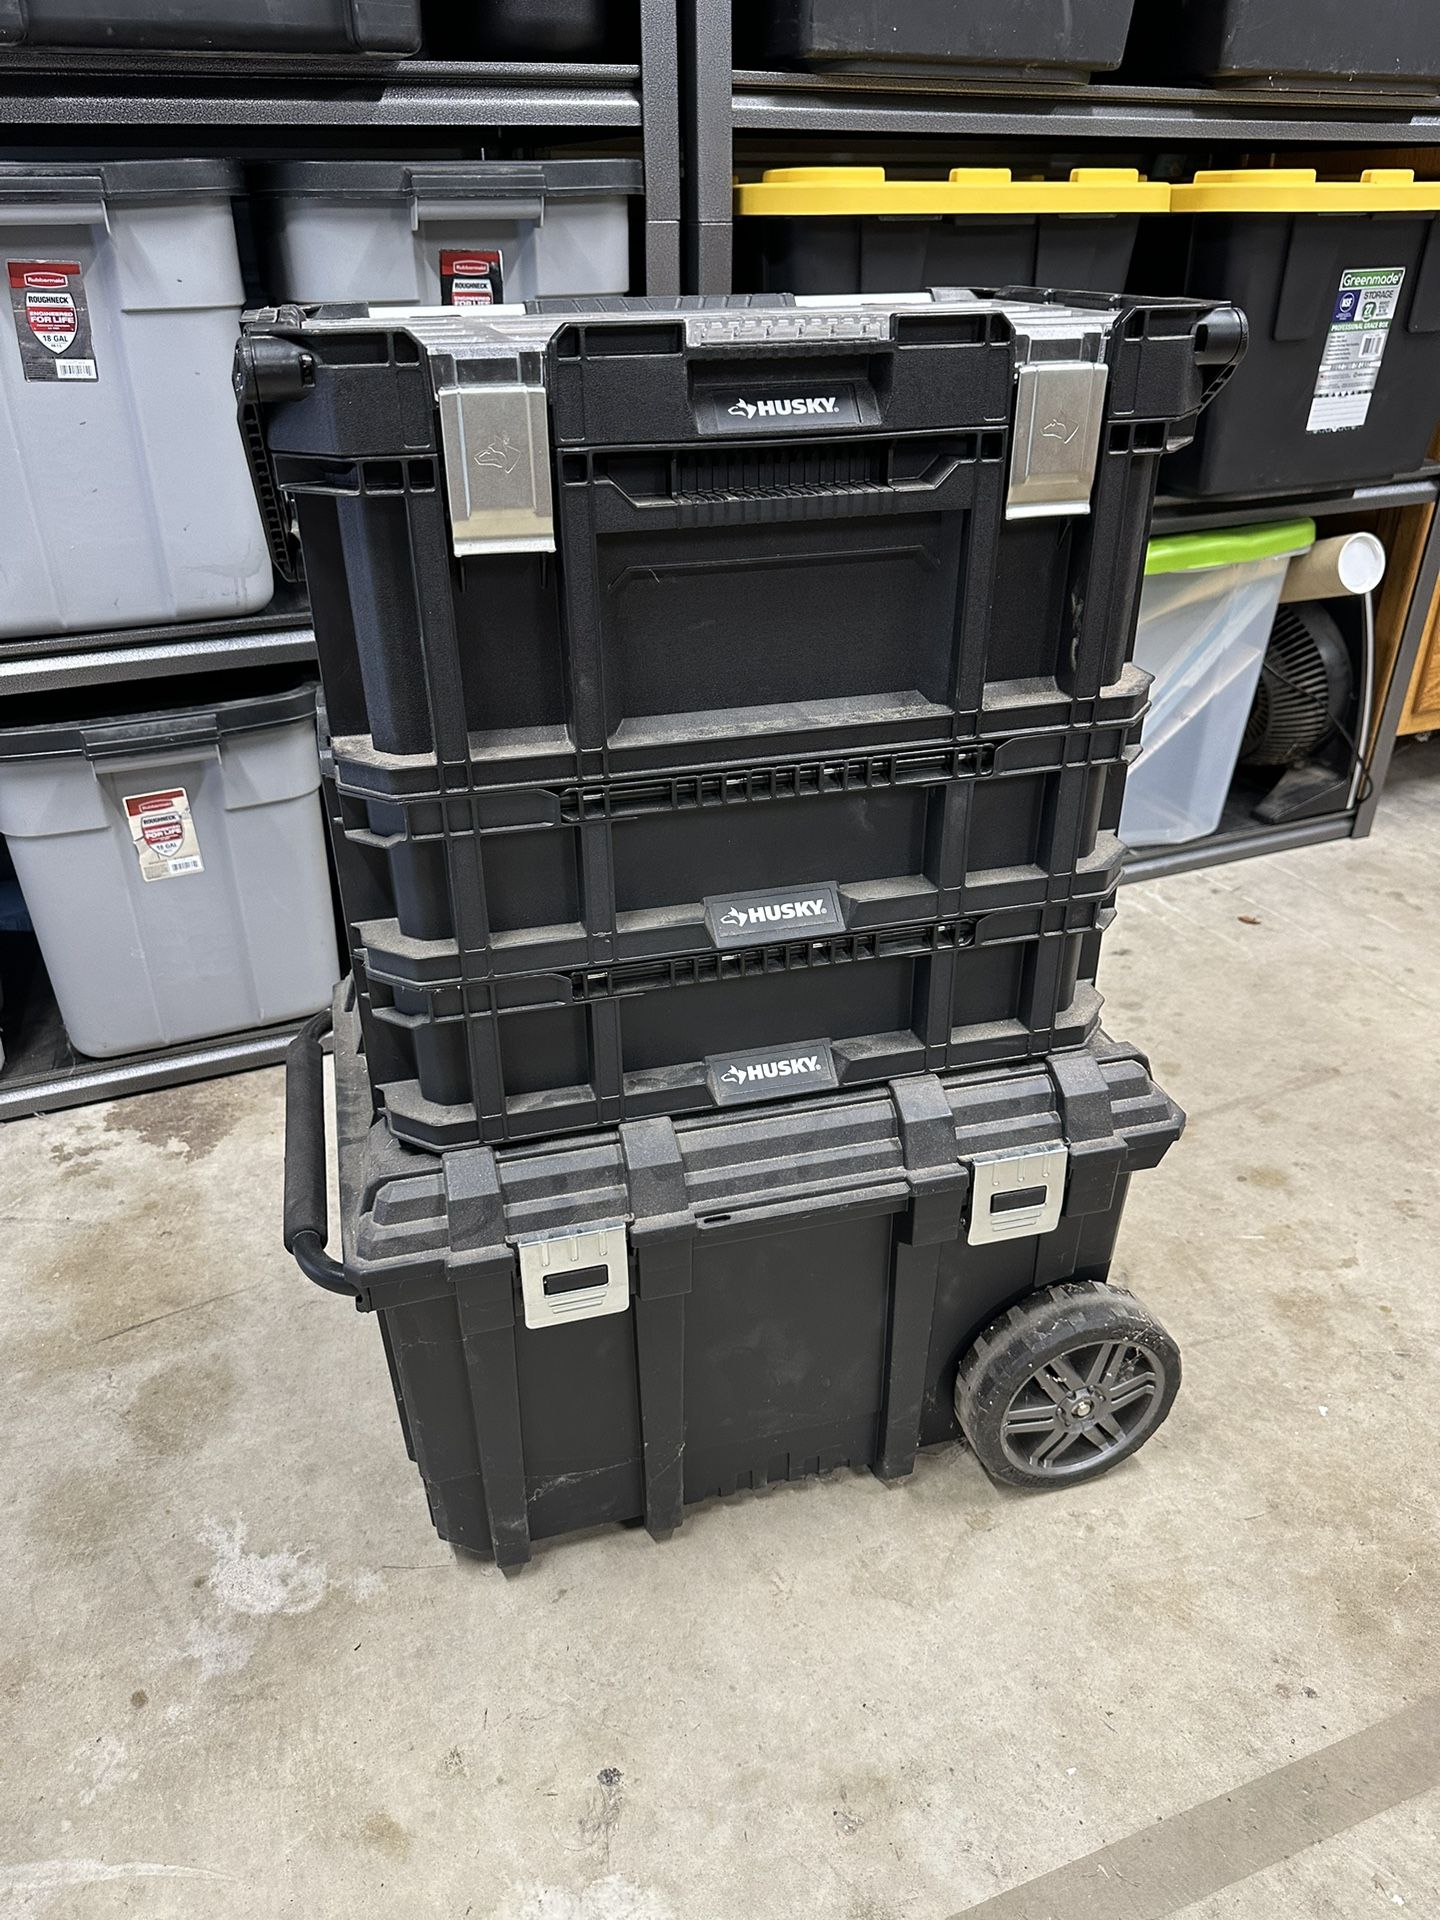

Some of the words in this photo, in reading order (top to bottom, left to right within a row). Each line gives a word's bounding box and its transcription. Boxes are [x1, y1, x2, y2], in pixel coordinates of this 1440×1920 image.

[1343, 272, 1399, 287] Greenmade
[28, 295, 69, 304] ROUGHNECK
[1363, 290, 1394, 300] STORAGE
[30, 316, 52, 324] FOR
[52, 316, 75, 324] LIFE
[43, 335, 52, 343] 18
[53, 335, 69, 343] GAL
[757, 397, 836, 417] HUSKY
[747, 899, 824, 923] HUSKY
[746, 1055, 819, 1081] HUSKY
